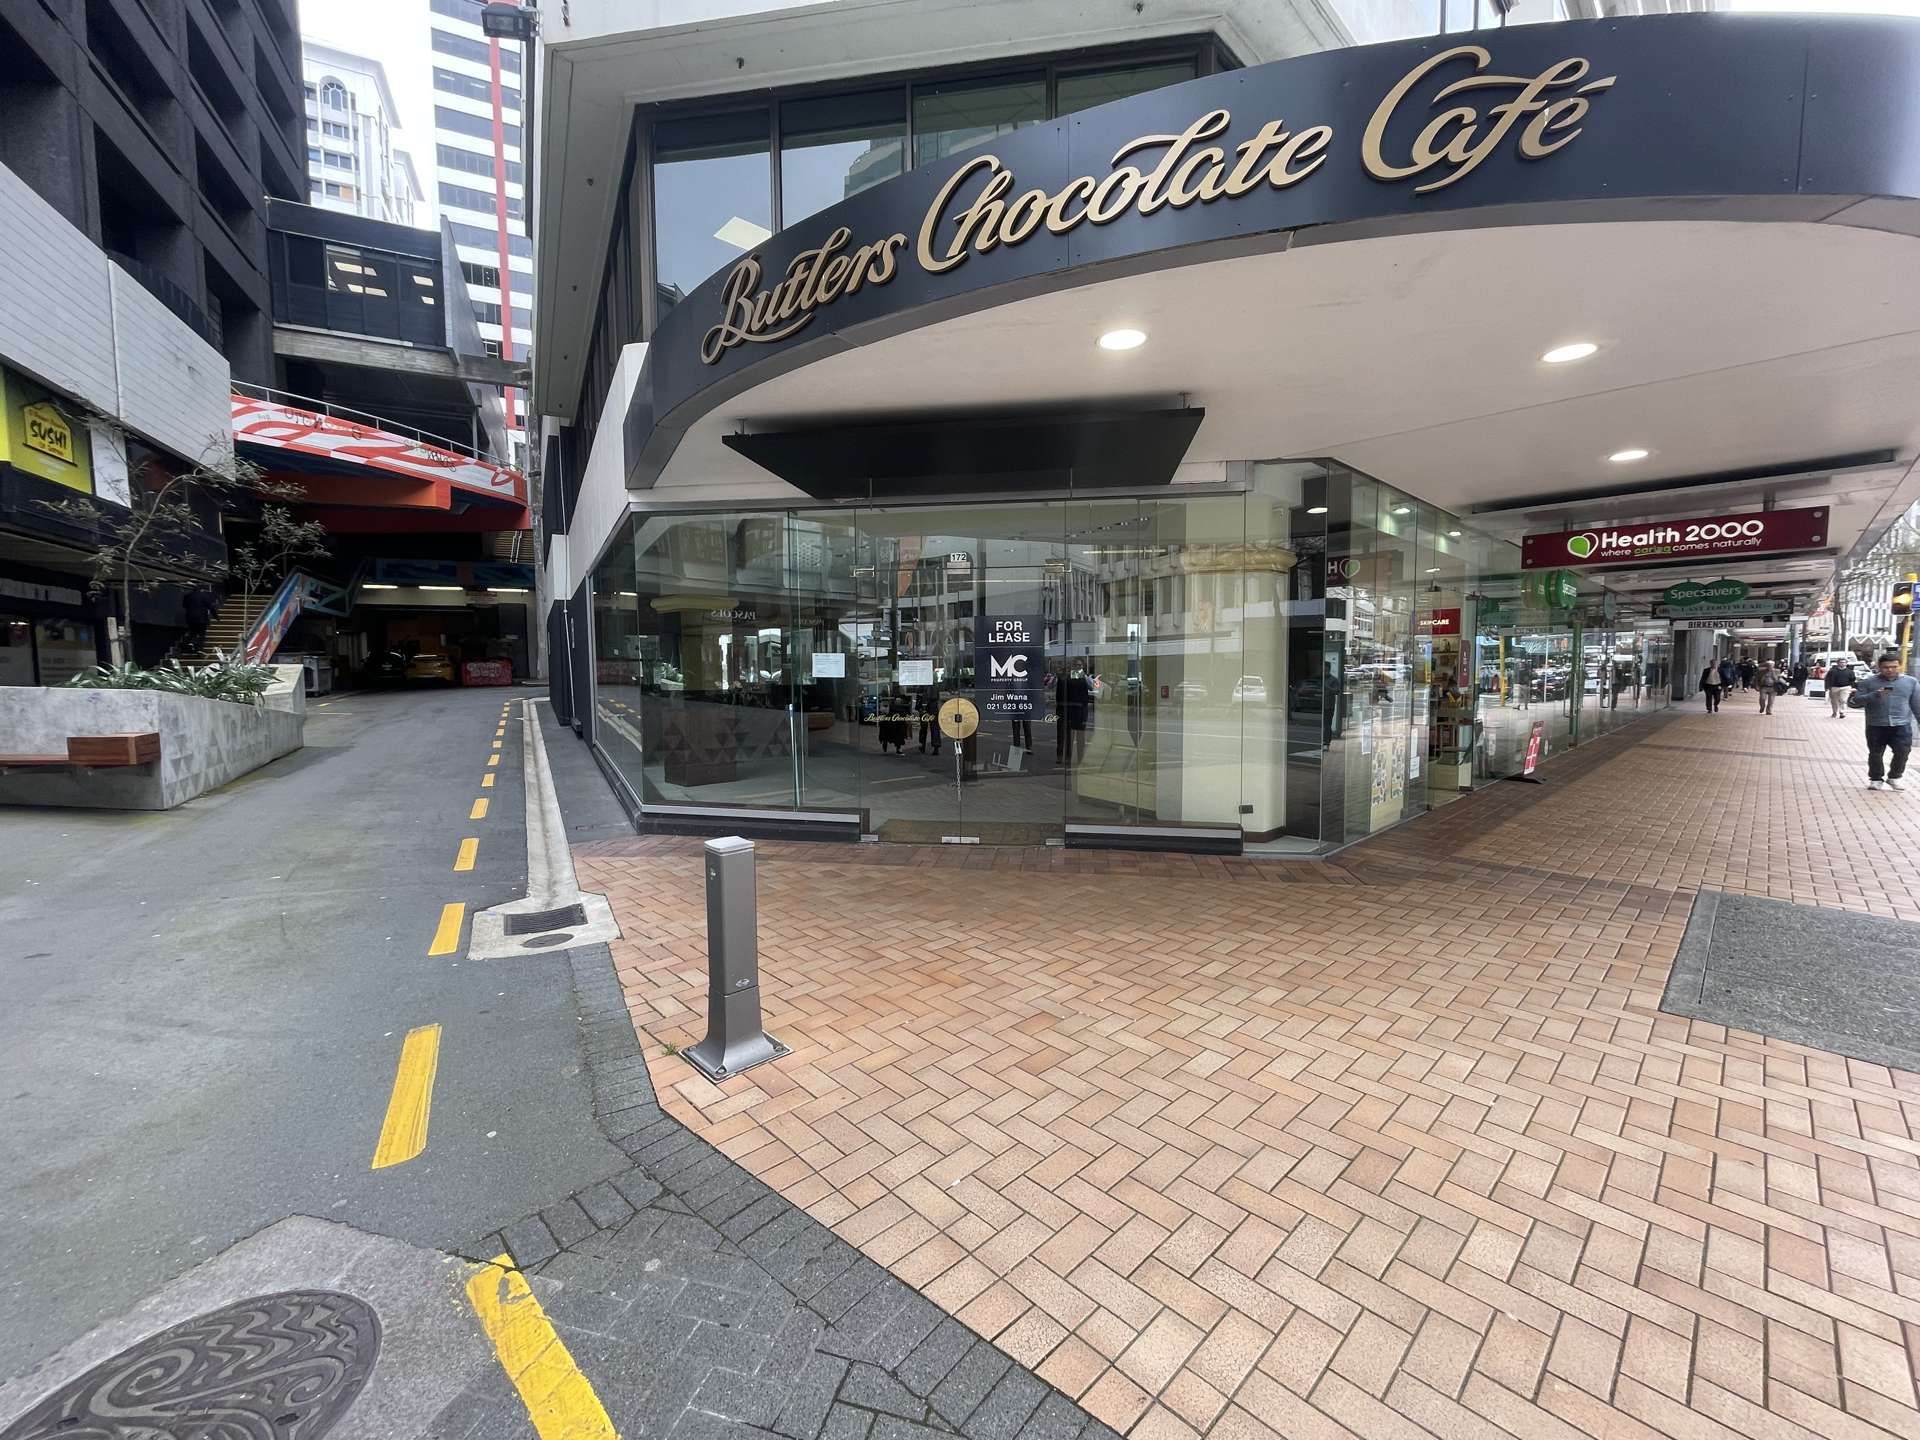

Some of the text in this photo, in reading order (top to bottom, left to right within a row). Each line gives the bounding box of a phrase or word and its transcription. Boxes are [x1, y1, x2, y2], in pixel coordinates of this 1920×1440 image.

[701, 45, 1617, 364] Butlers Chocolate Café
[30, 420, 67, 449] SUSHI
[1601, 520, 1764, 548] Health 2000
[1600, 547, 1632, 557] where
[1672, 541, 1710, 552] comes
[1713, 538, 1762, 549] naturally
[951, 553, 967, 561] 172
[1670, 586, 1741, 600] Specsavers
[995, 620, 1023, 632] FOR
[1687, 620, 1745, 629] BIRKENSTOCK
[988, 632, 1031, 643] LEASE
[990, 654, 1028, 677] MC
[990, 693, 1005, 701] Jim
